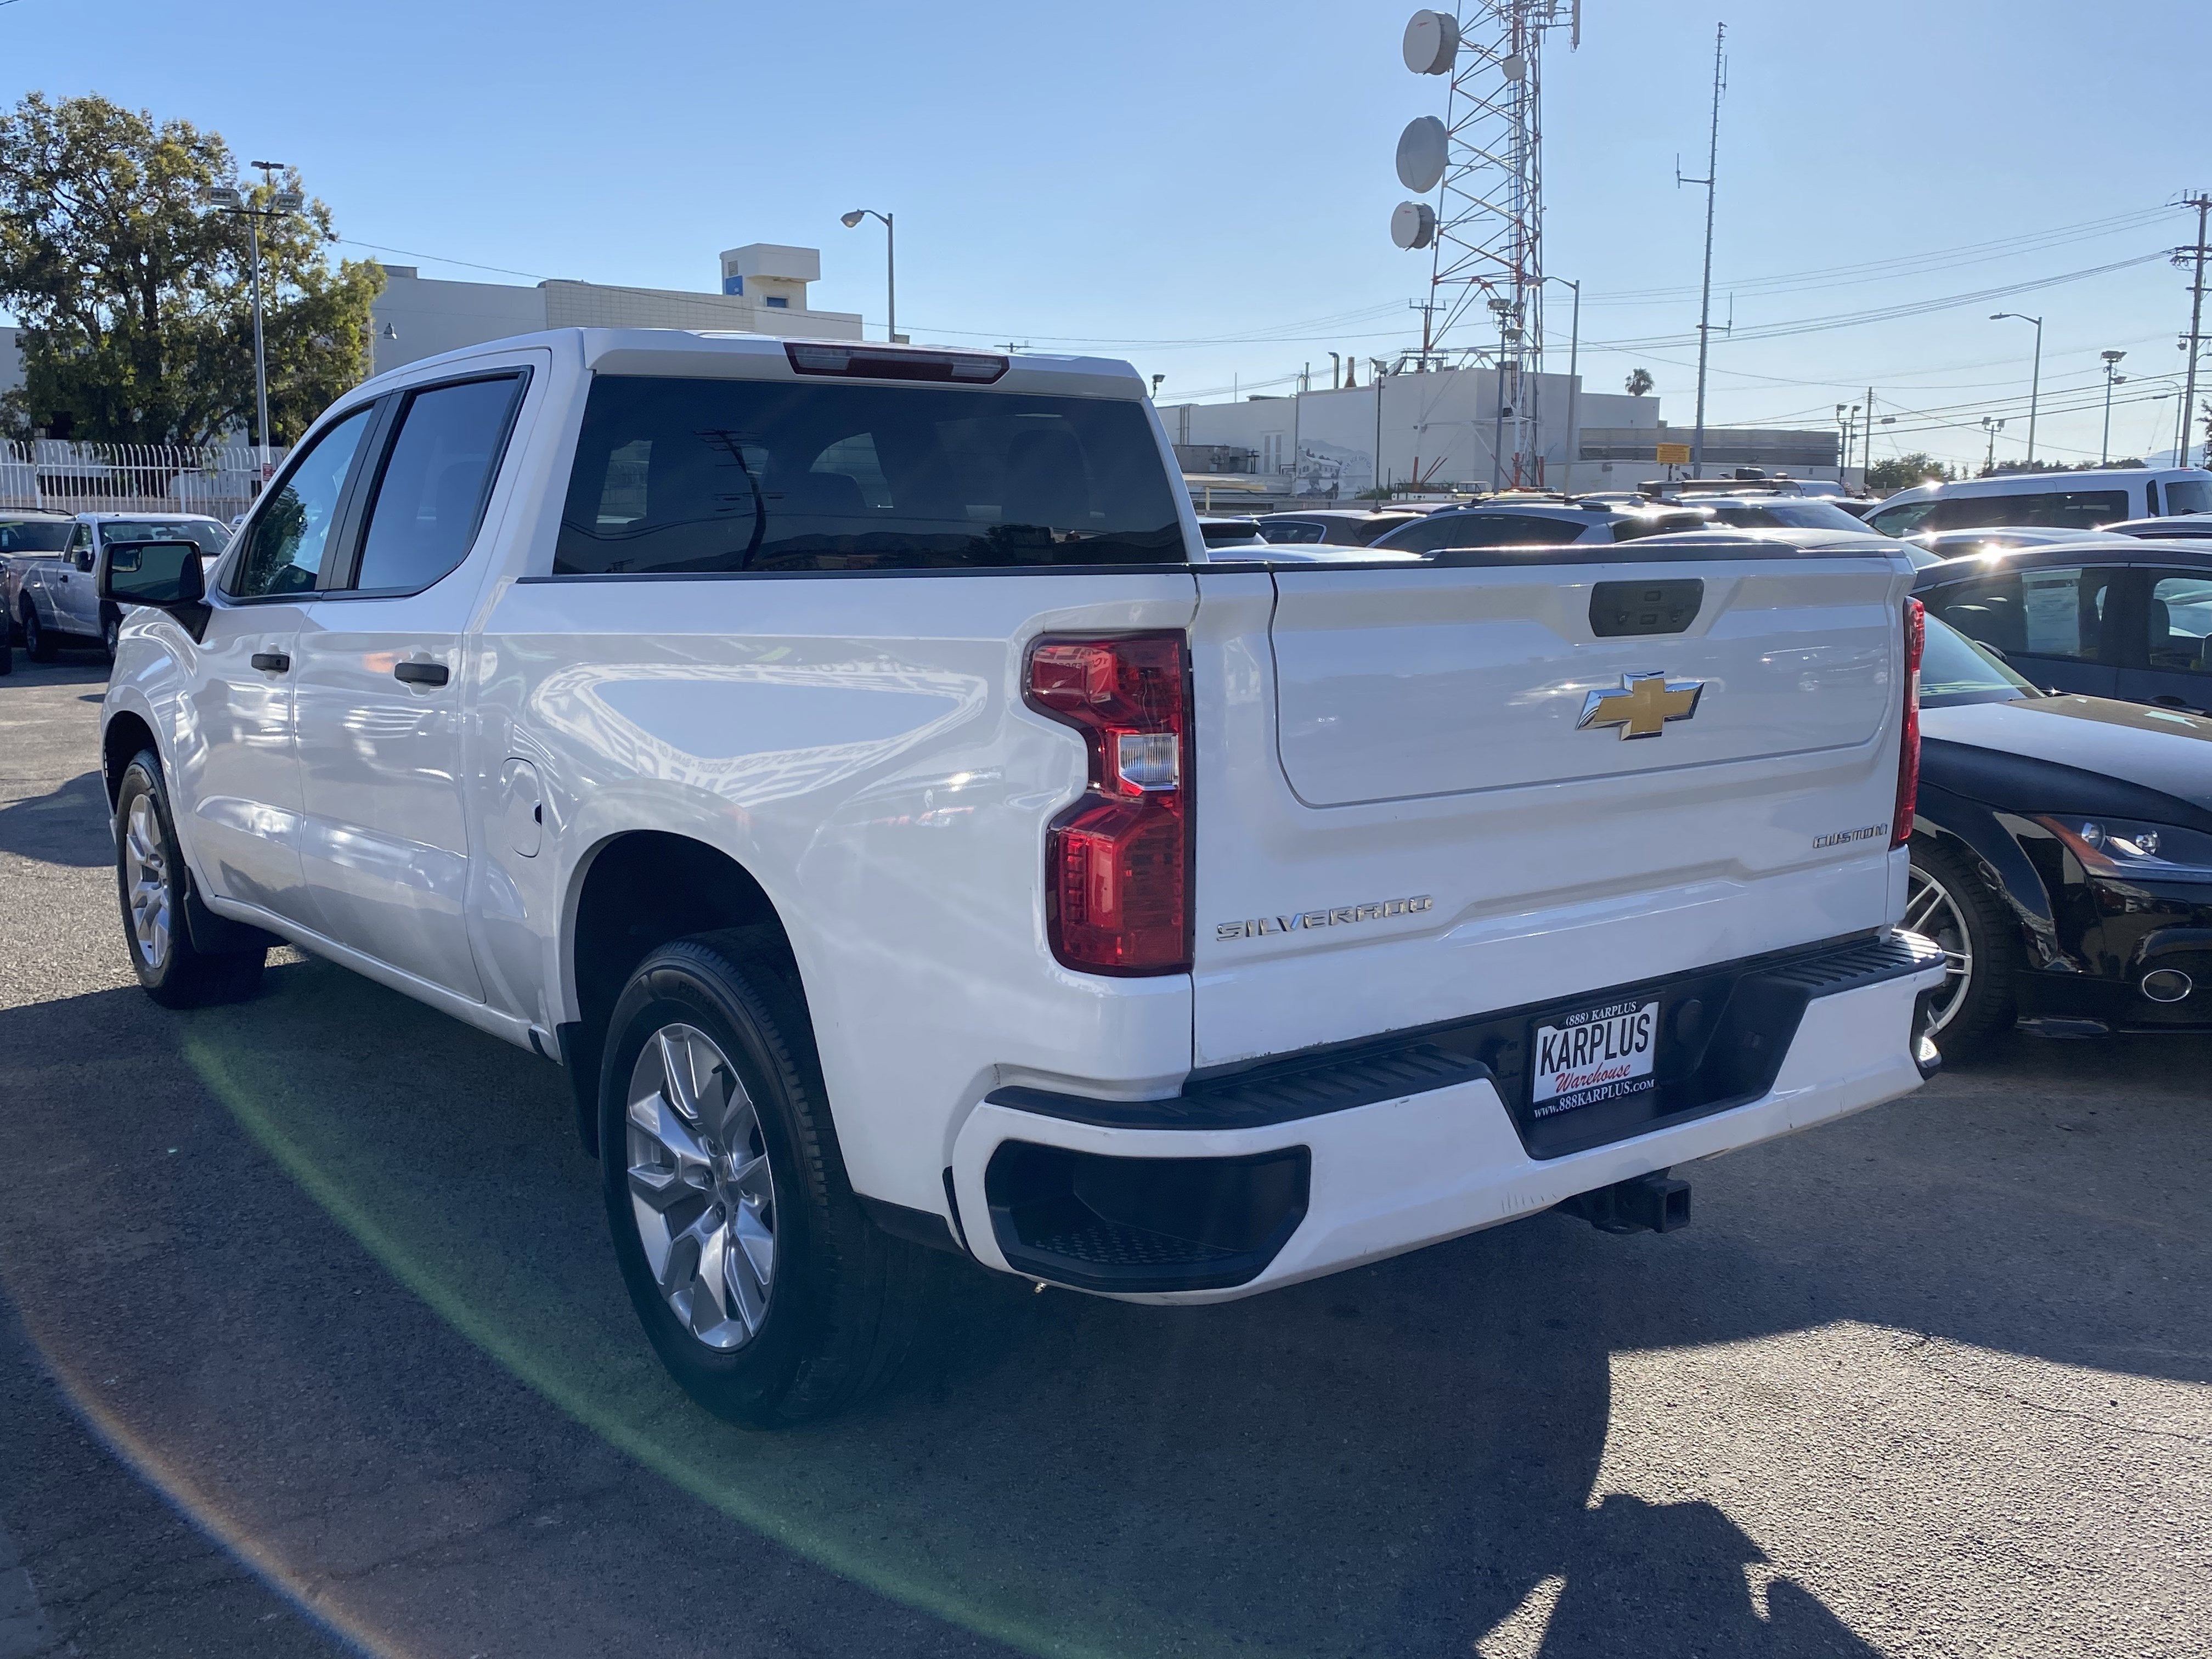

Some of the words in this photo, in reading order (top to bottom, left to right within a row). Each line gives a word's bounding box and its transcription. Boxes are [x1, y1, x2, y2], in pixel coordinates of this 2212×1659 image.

[1813, 823, 1888, 848] CUSTOM
[1216, 895, 1432, 941] SILVERADO
[1566, 1012, 1589, 1026] (888)
[1592, 1001, 1637, 1020] KARPLUS
[1540, 1013, 1650, 1076] KARPLUS
[1555, 1062, 1630, 1094] Warehouse
